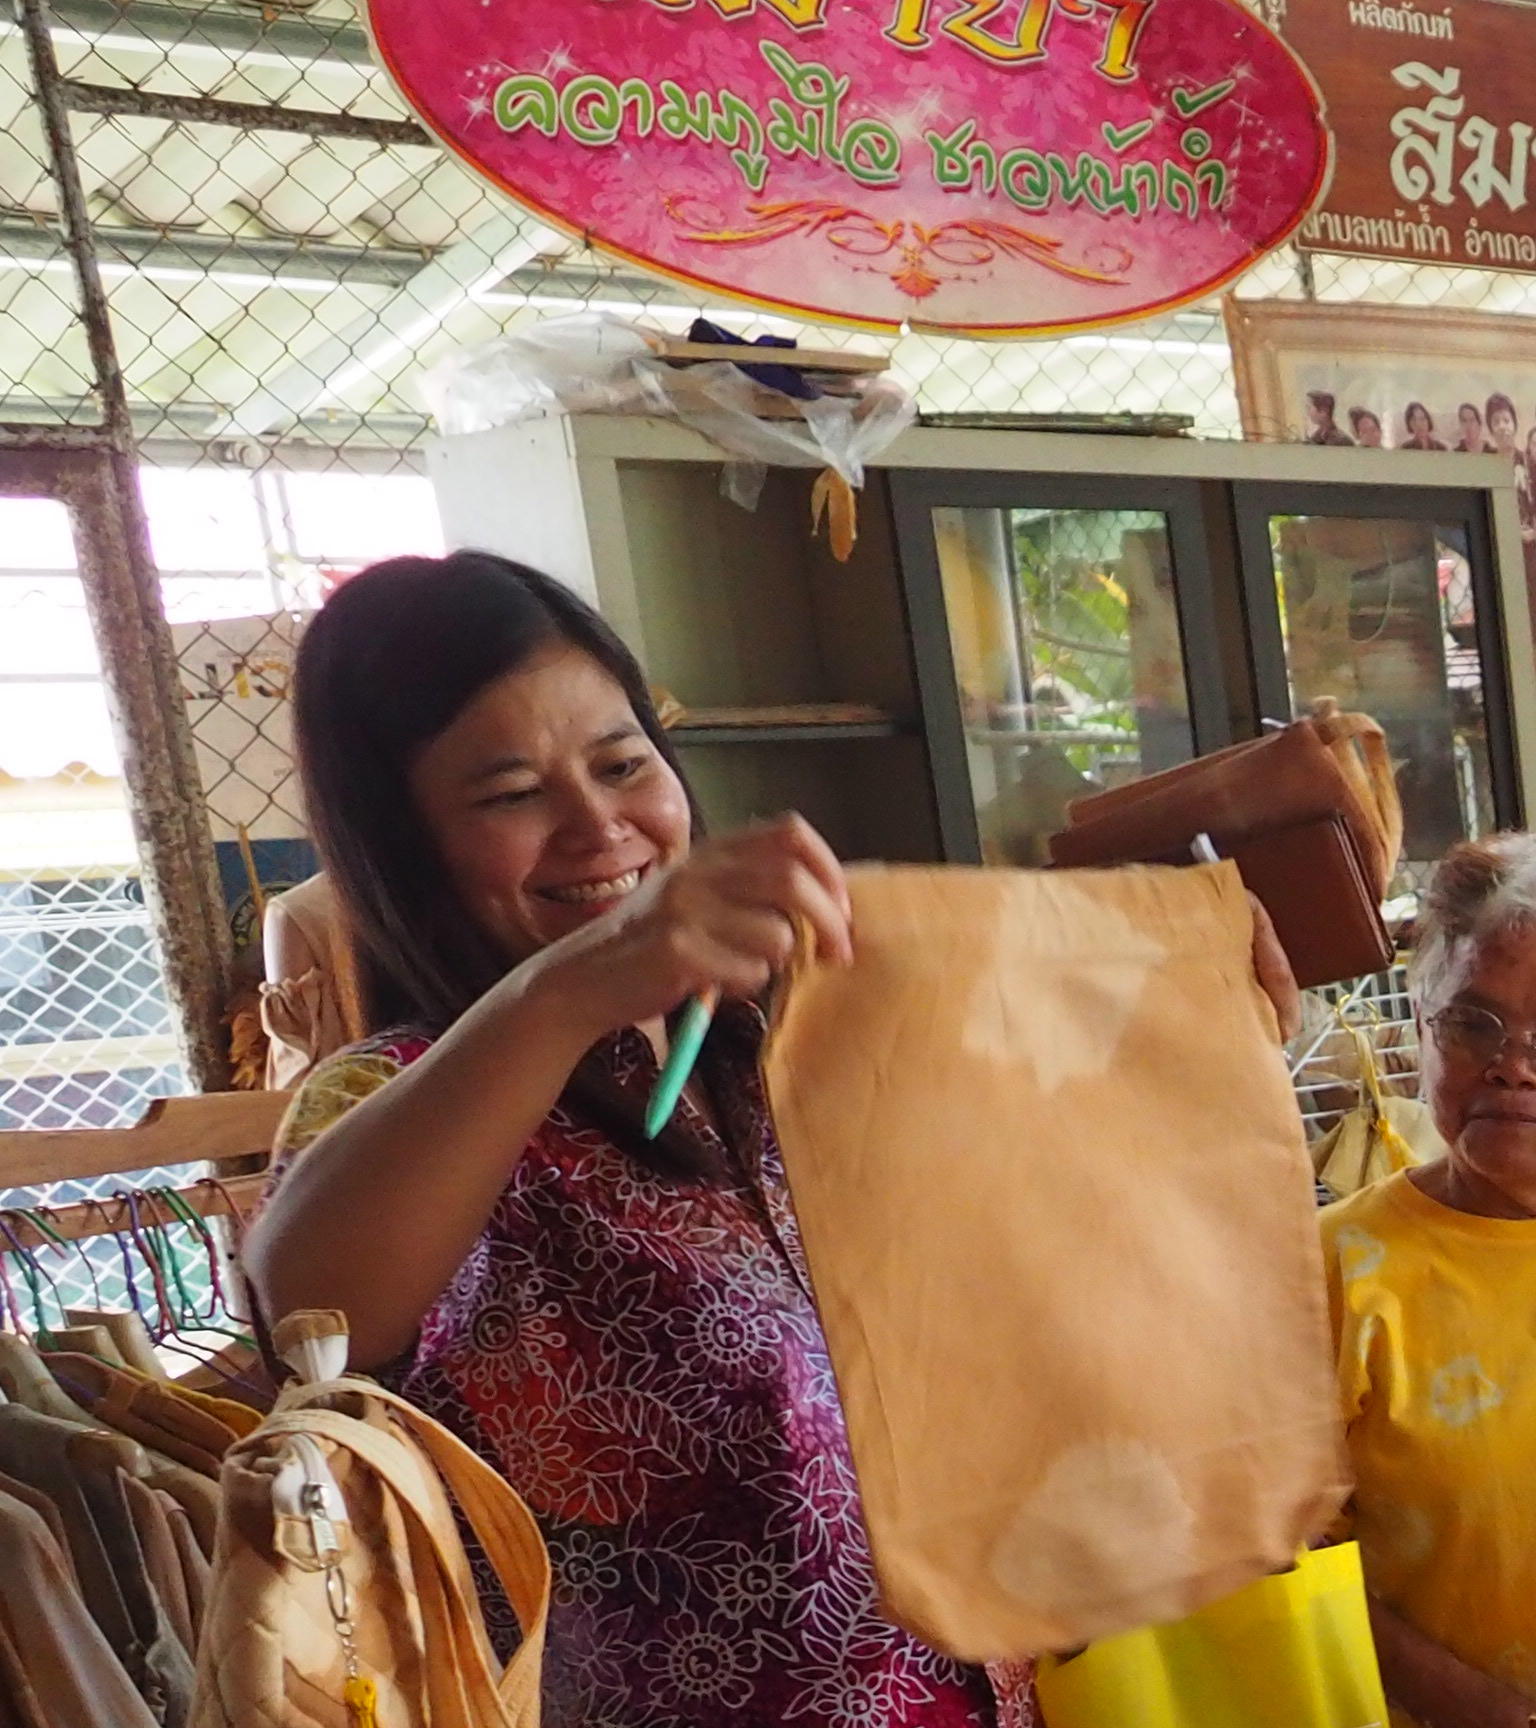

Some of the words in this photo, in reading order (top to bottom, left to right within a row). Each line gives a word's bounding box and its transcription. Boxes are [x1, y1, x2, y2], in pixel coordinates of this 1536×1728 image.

[492, 39, 902, 191] ความภูมิใจ
[923, 79, 1238, 214] ชาวหน้าถ้ำ
